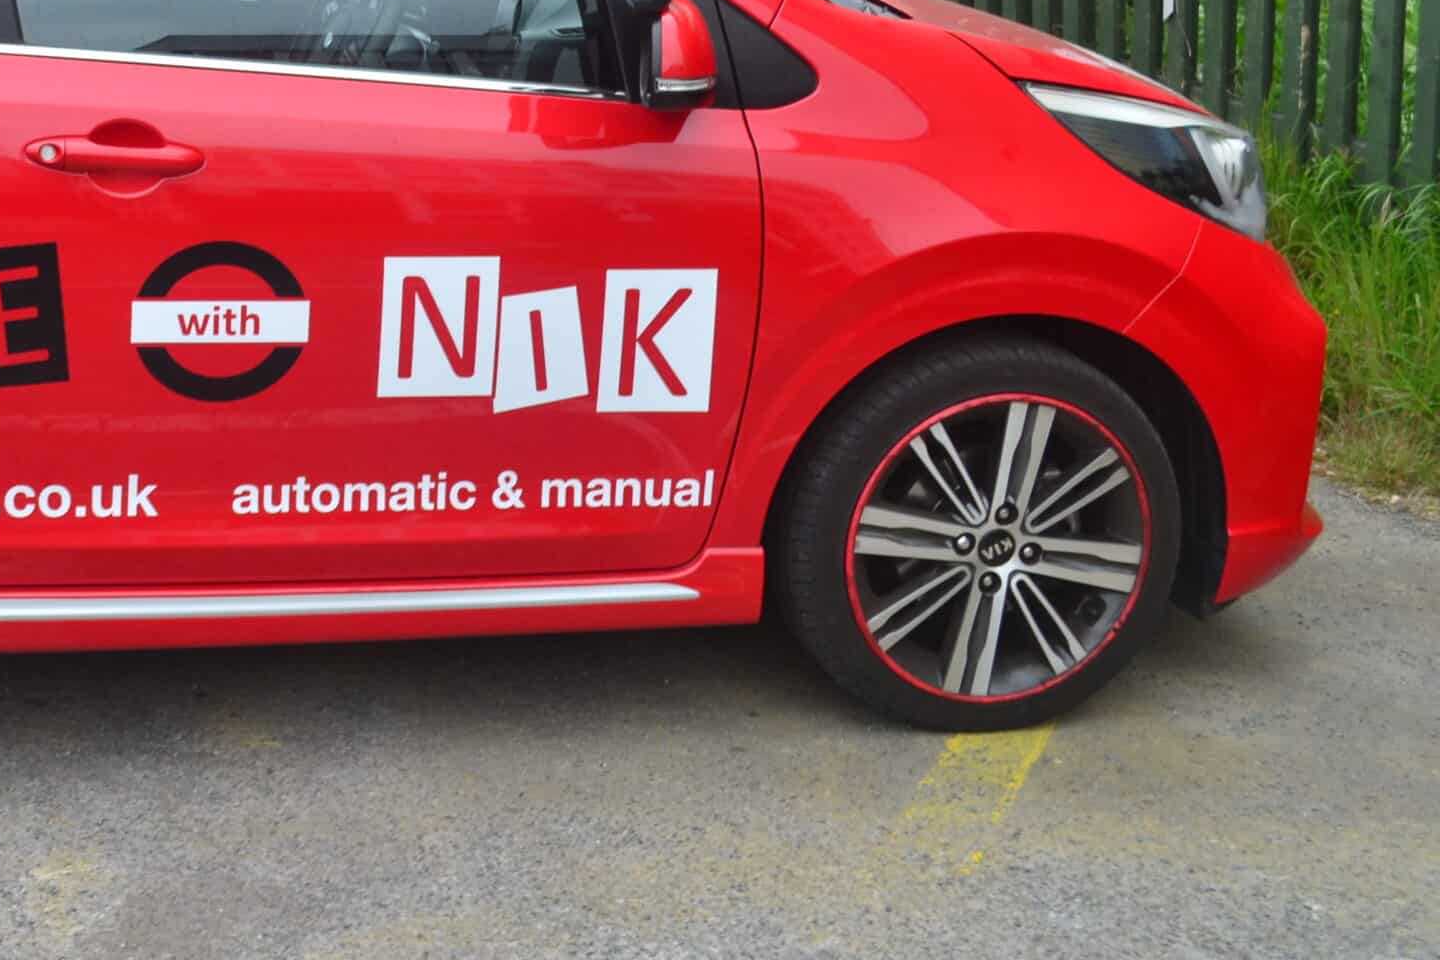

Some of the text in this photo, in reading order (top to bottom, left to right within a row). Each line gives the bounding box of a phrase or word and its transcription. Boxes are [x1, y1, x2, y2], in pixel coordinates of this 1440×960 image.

[177, 305, 261, 337] with
[396, 275, 694, 397] NIK
[231, 470, 717, 515] automatic & manual
